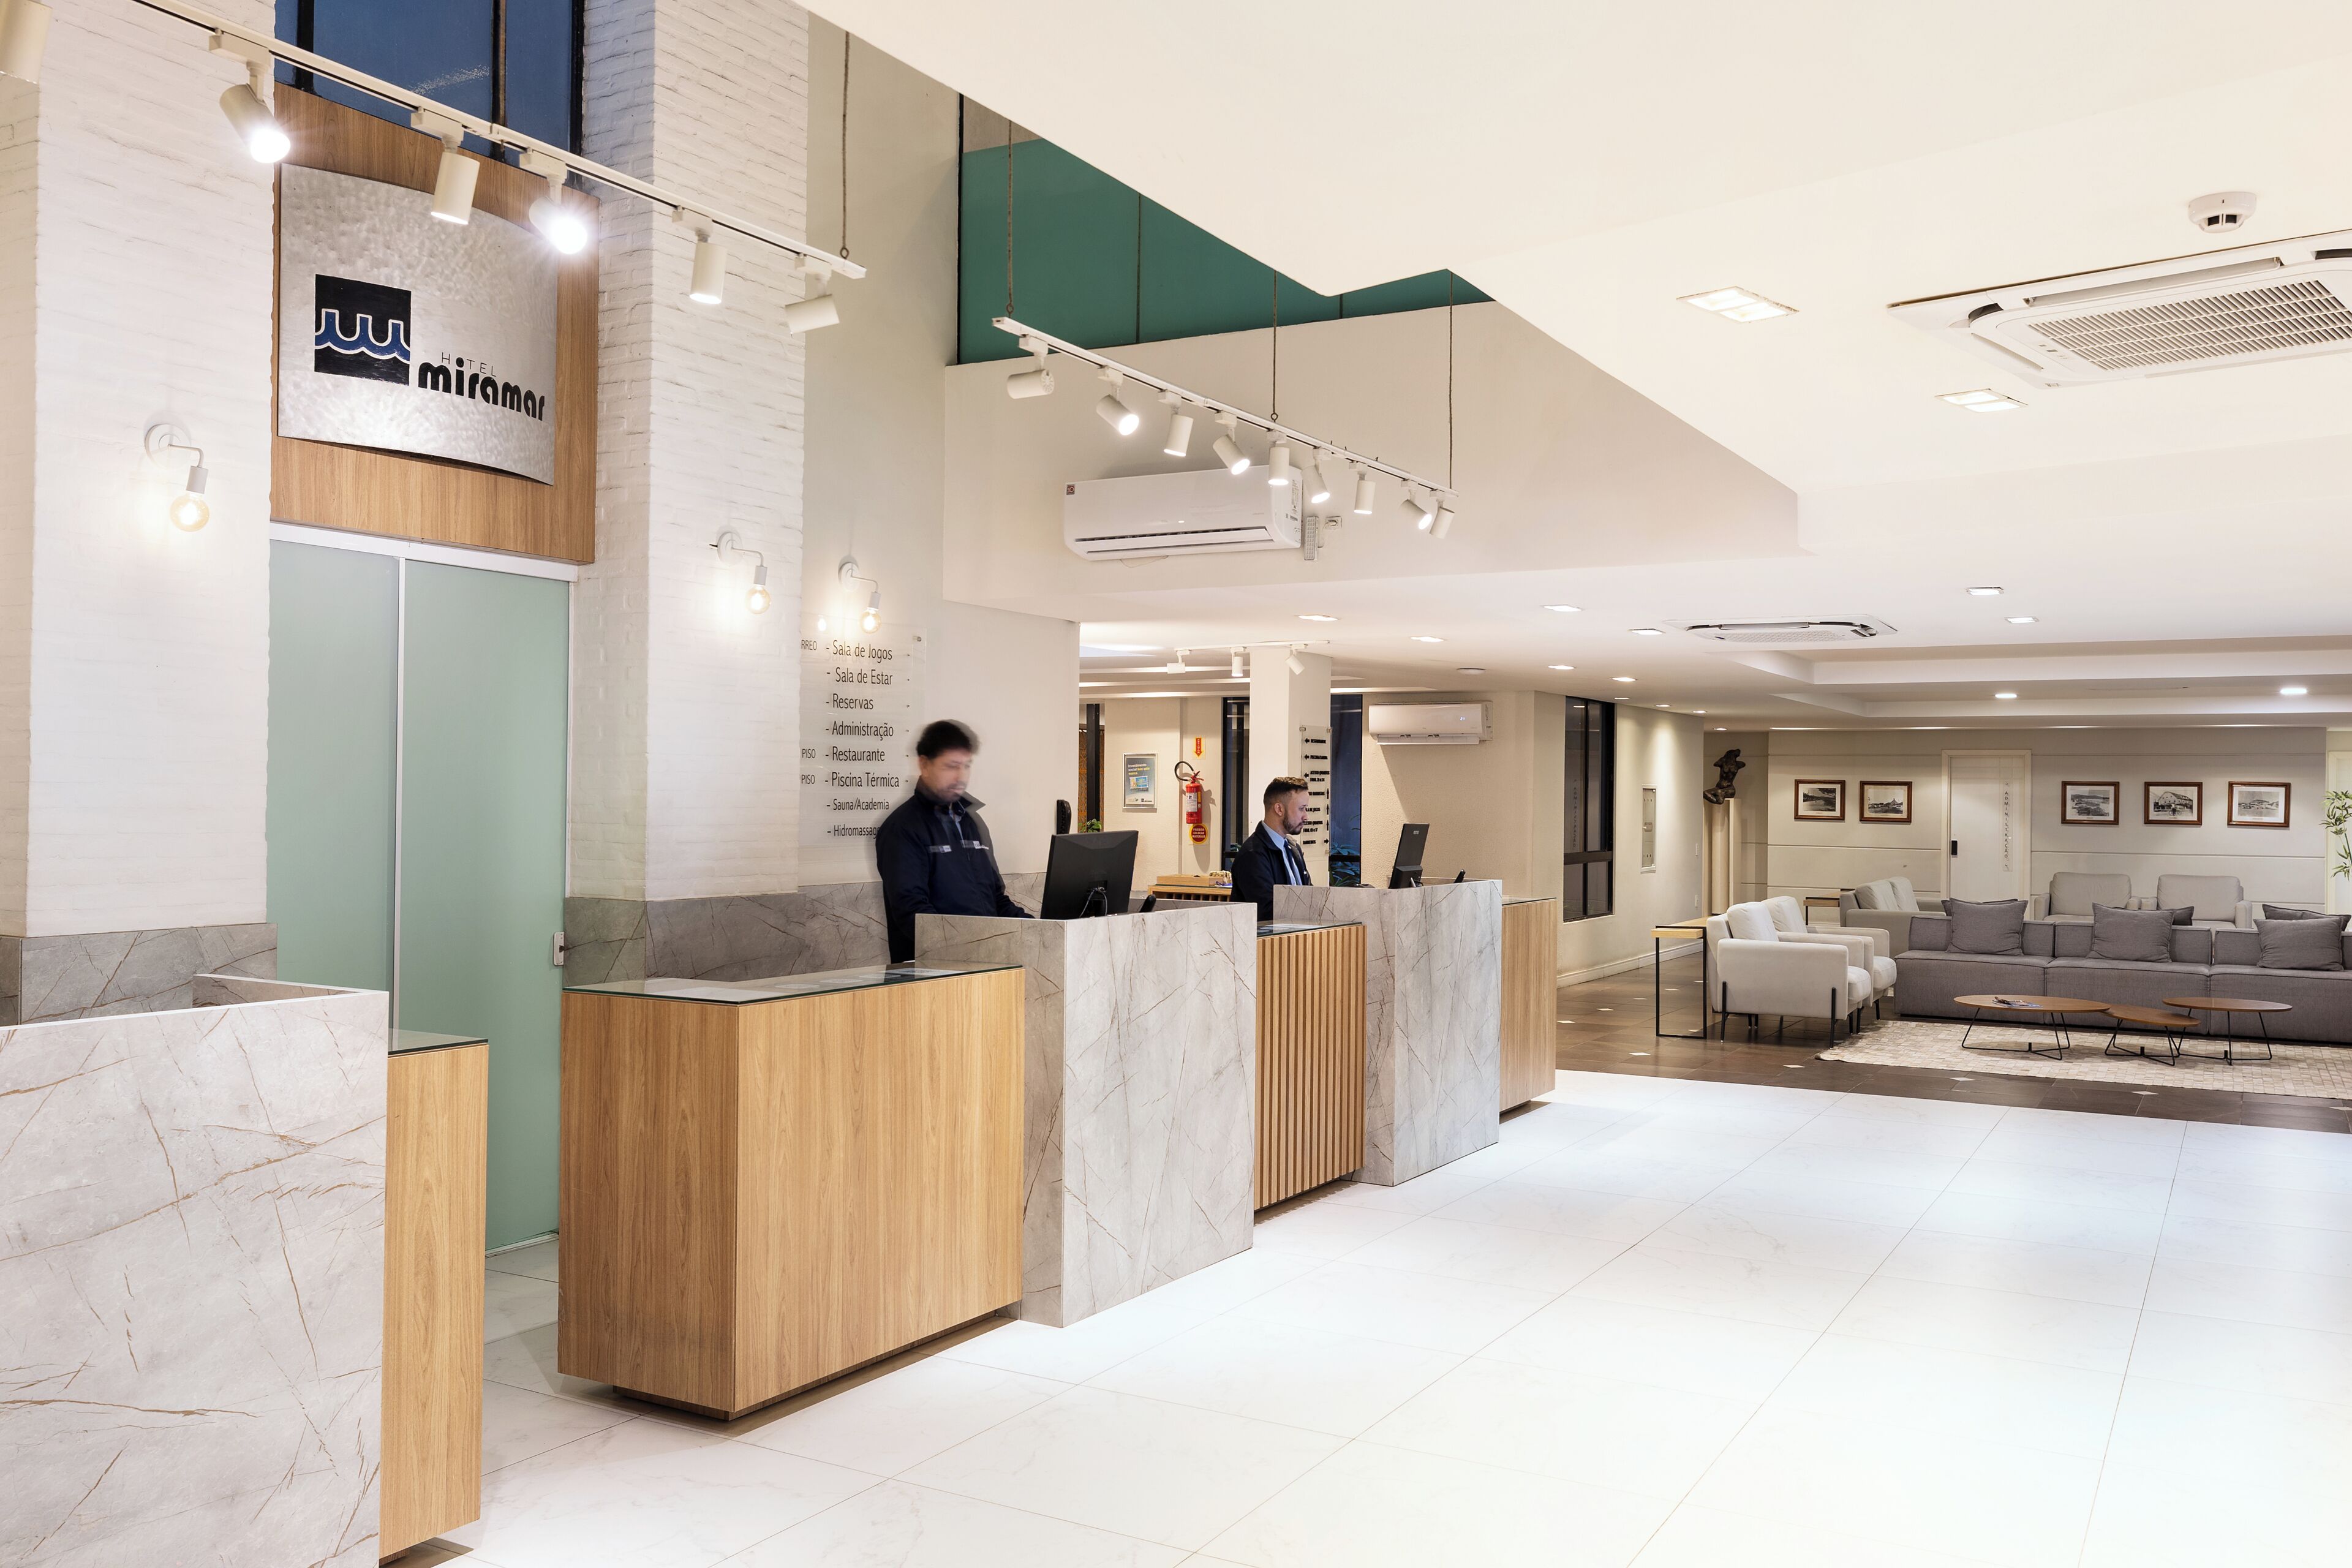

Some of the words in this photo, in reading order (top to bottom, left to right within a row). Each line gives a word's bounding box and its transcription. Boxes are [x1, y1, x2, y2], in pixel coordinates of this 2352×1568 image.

[442, 352, 496, 377] HOTEL
[418, 357, 545, 421] miramar
[801, 639, 817, 650] RREO
[833, 639, 851, 656] Sala
[854, 643, 865, 658] de
[868, 644, 892, 663] Jogos
[835, 667, 854, 683] Sala
[857, 669, 868, 684] de
[871, 669, 892, 685] Estar
[833, 693, 874, 709] Reservas
[832, 720, 894, 741] Administração
[802, 748, 816, 759] PISO
[832, 746, 885, 761] Restaurante
[801, 774, 815, 784] PISO
[832, 772, 862, 787] Piscina
[865, 772, 899, 787] Térmica
[833, 797, 889, 810] Sauna/Academia
[834, 824, 880, 839] Hidromassag
